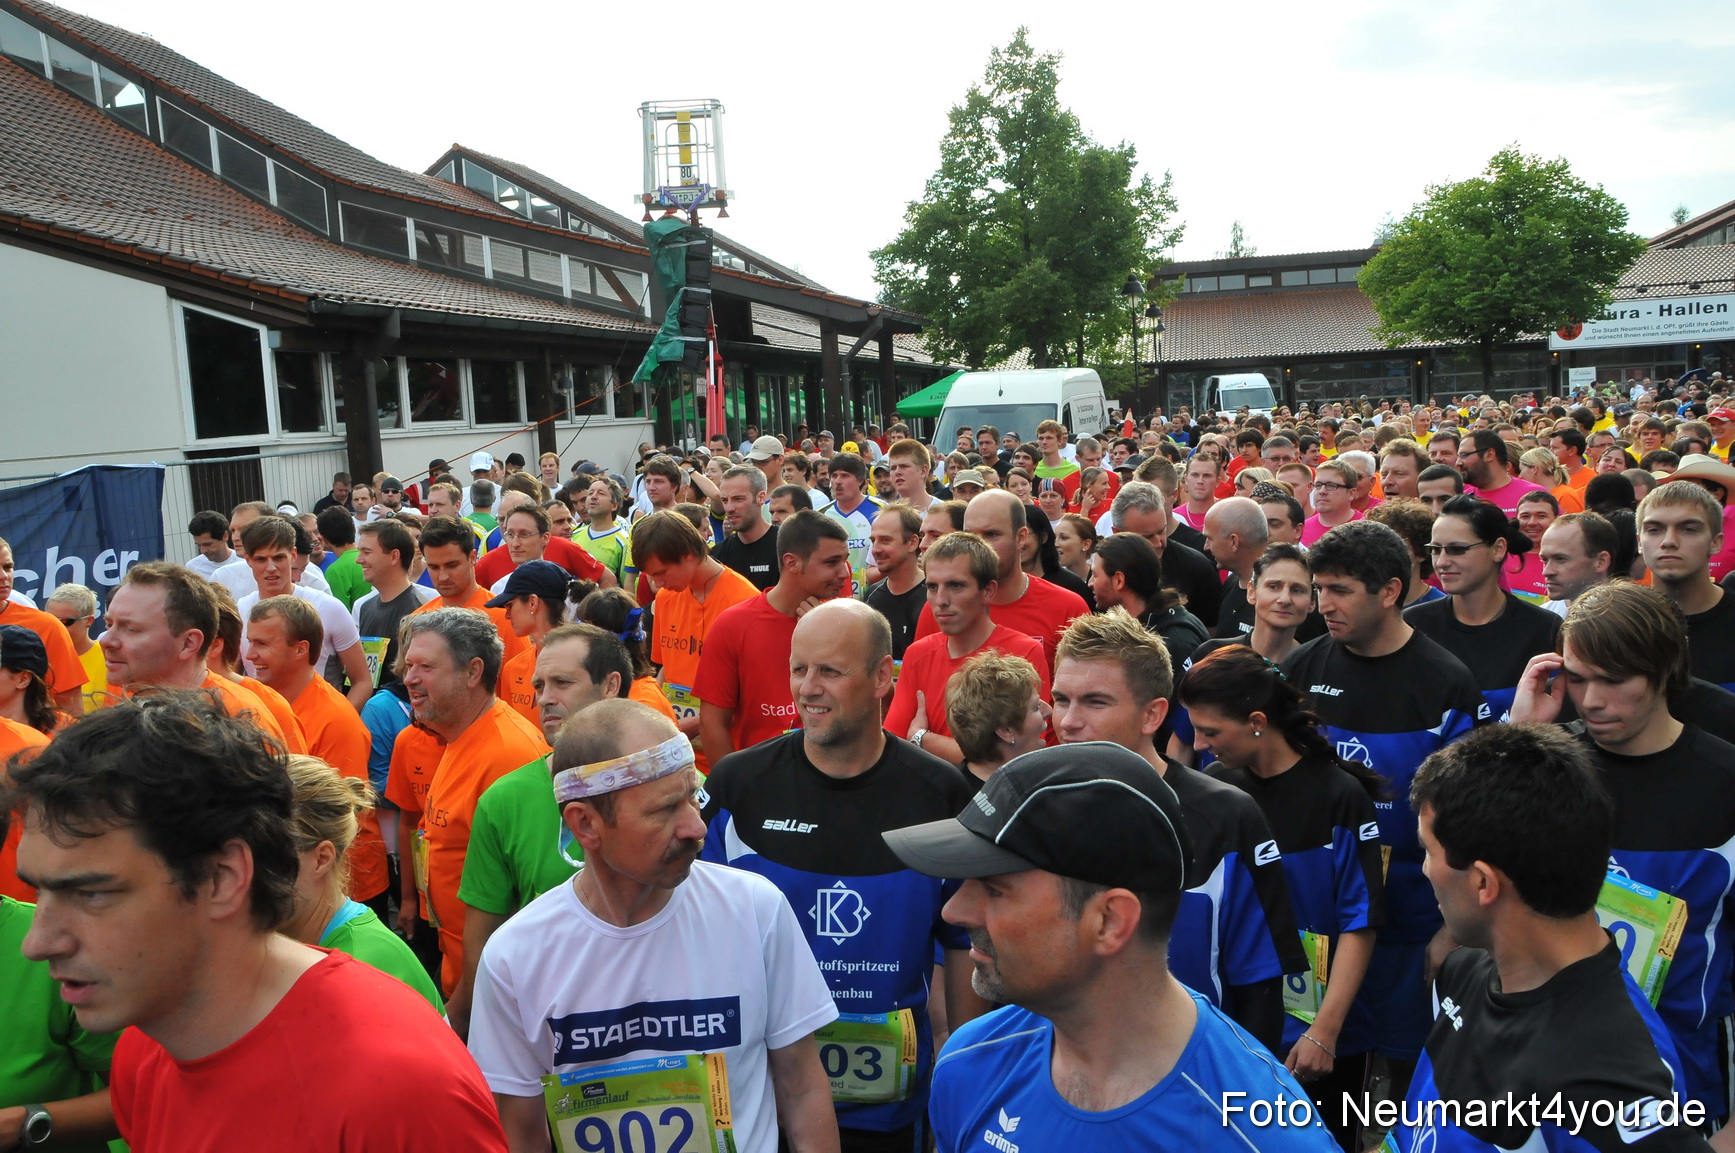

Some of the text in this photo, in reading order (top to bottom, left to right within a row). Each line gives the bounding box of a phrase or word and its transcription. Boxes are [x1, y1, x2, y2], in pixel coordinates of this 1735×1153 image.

[680, 166, 692, 178] 80
[1659, 302, 1728, 317] Hallen
[1661, 328, 1701, 337] angenehmen
[761, 702, 799, 716] Stad
[1374, 801, 1393, 810] erei
[762, 819, 818, 833] saller
[571, 1013, 727, 1050] STAEDTLER
[572, 1090, 629, 1110] firmenlauf
[574, 1107, 694, 1153] 902
[984, 1129, 1019, 1153] erima
